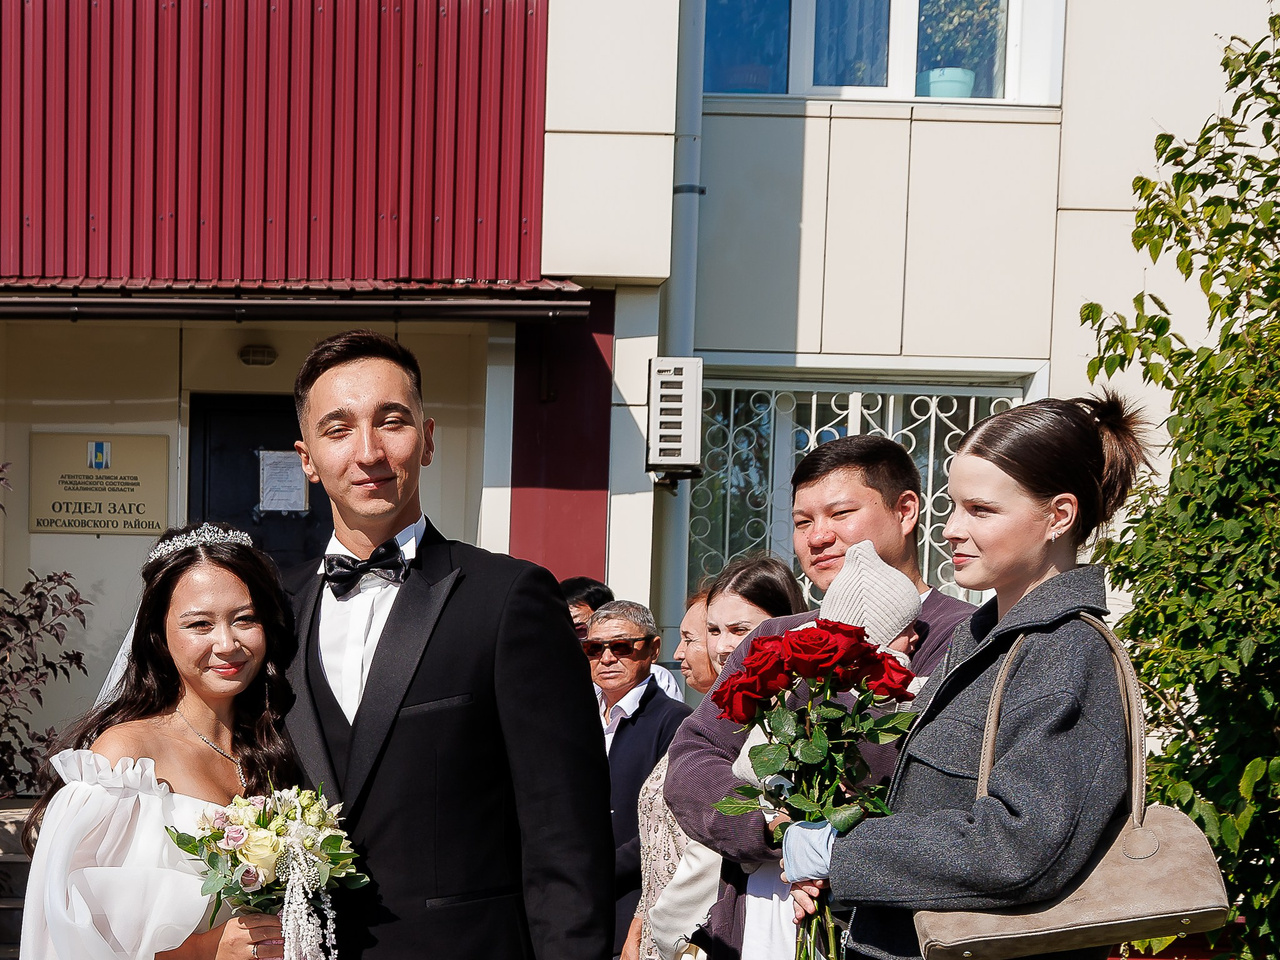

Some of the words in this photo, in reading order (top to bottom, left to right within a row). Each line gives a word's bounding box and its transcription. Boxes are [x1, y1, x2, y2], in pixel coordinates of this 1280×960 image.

[51, 501, 102, 515] ОТДЕЛ
[107, 502, 146, 515] ЗАГС
[36, 518, 119, 529] КОРСАКОВСКОГО
[123, 518, 161, 530] РАЙОНА
